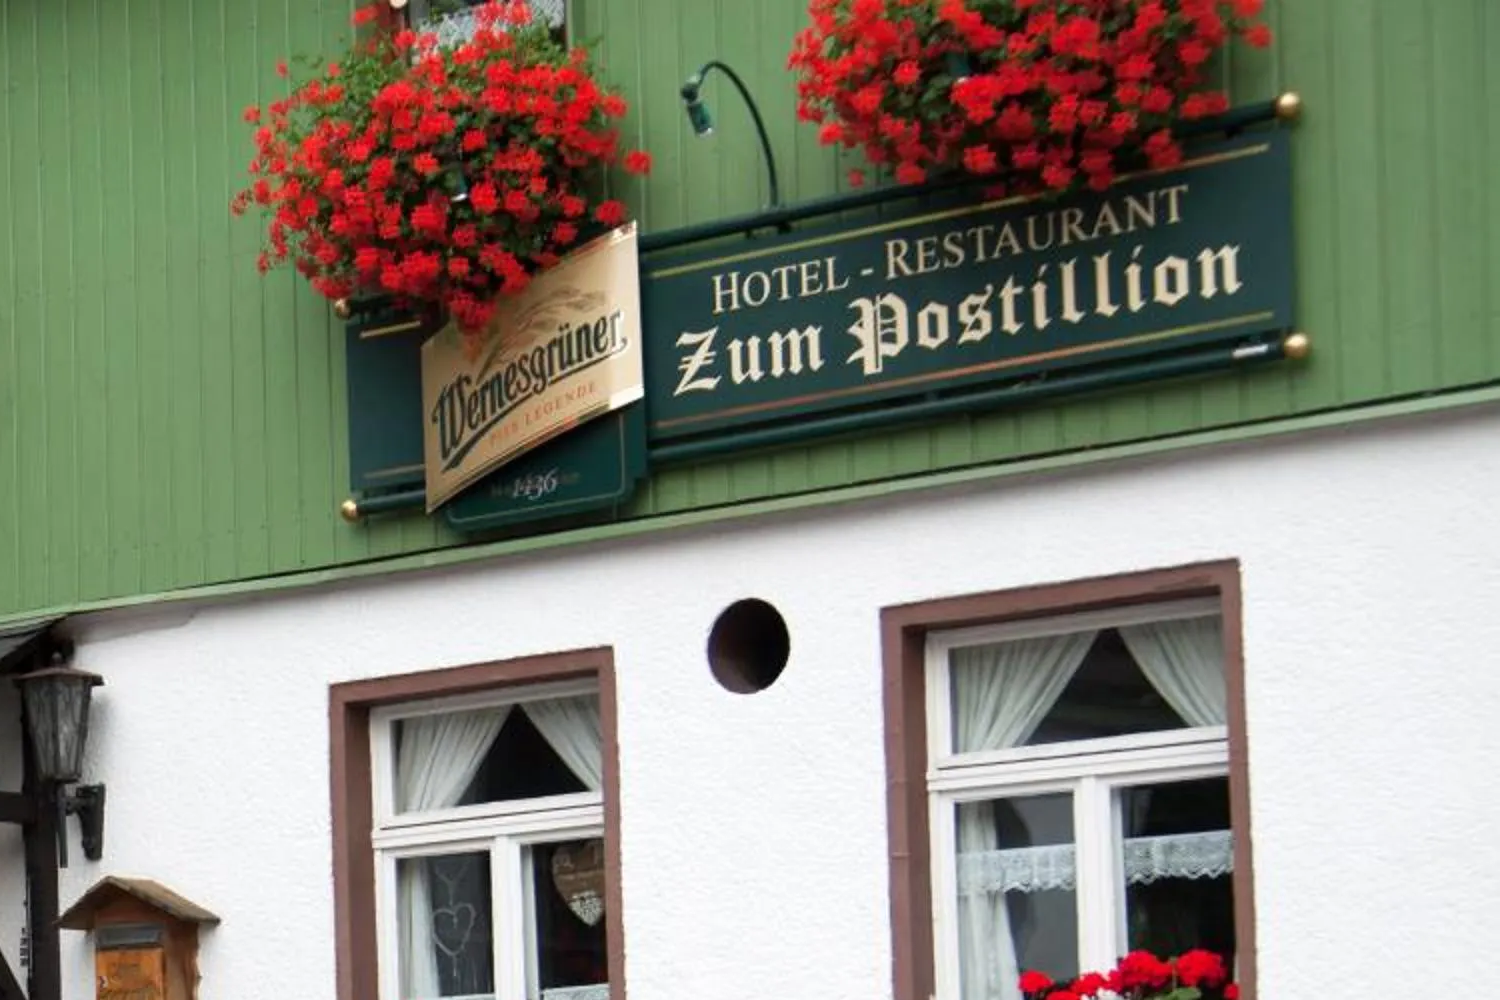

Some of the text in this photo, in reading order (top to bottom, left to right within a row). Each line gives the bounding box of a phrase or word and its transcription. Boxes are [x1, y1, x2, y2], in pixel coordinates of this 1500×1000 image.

[712, 256, 850, 315] HOTEL
[885, 184, 1189, 281] RESTAURANT
[431, 309, 625, 461] Wernesgrüner
[673, 243, 1244, 397] Zum Postillion
[524, 381, 597, 424] LEGENDE
[513, 467, 560, 500] 1436
